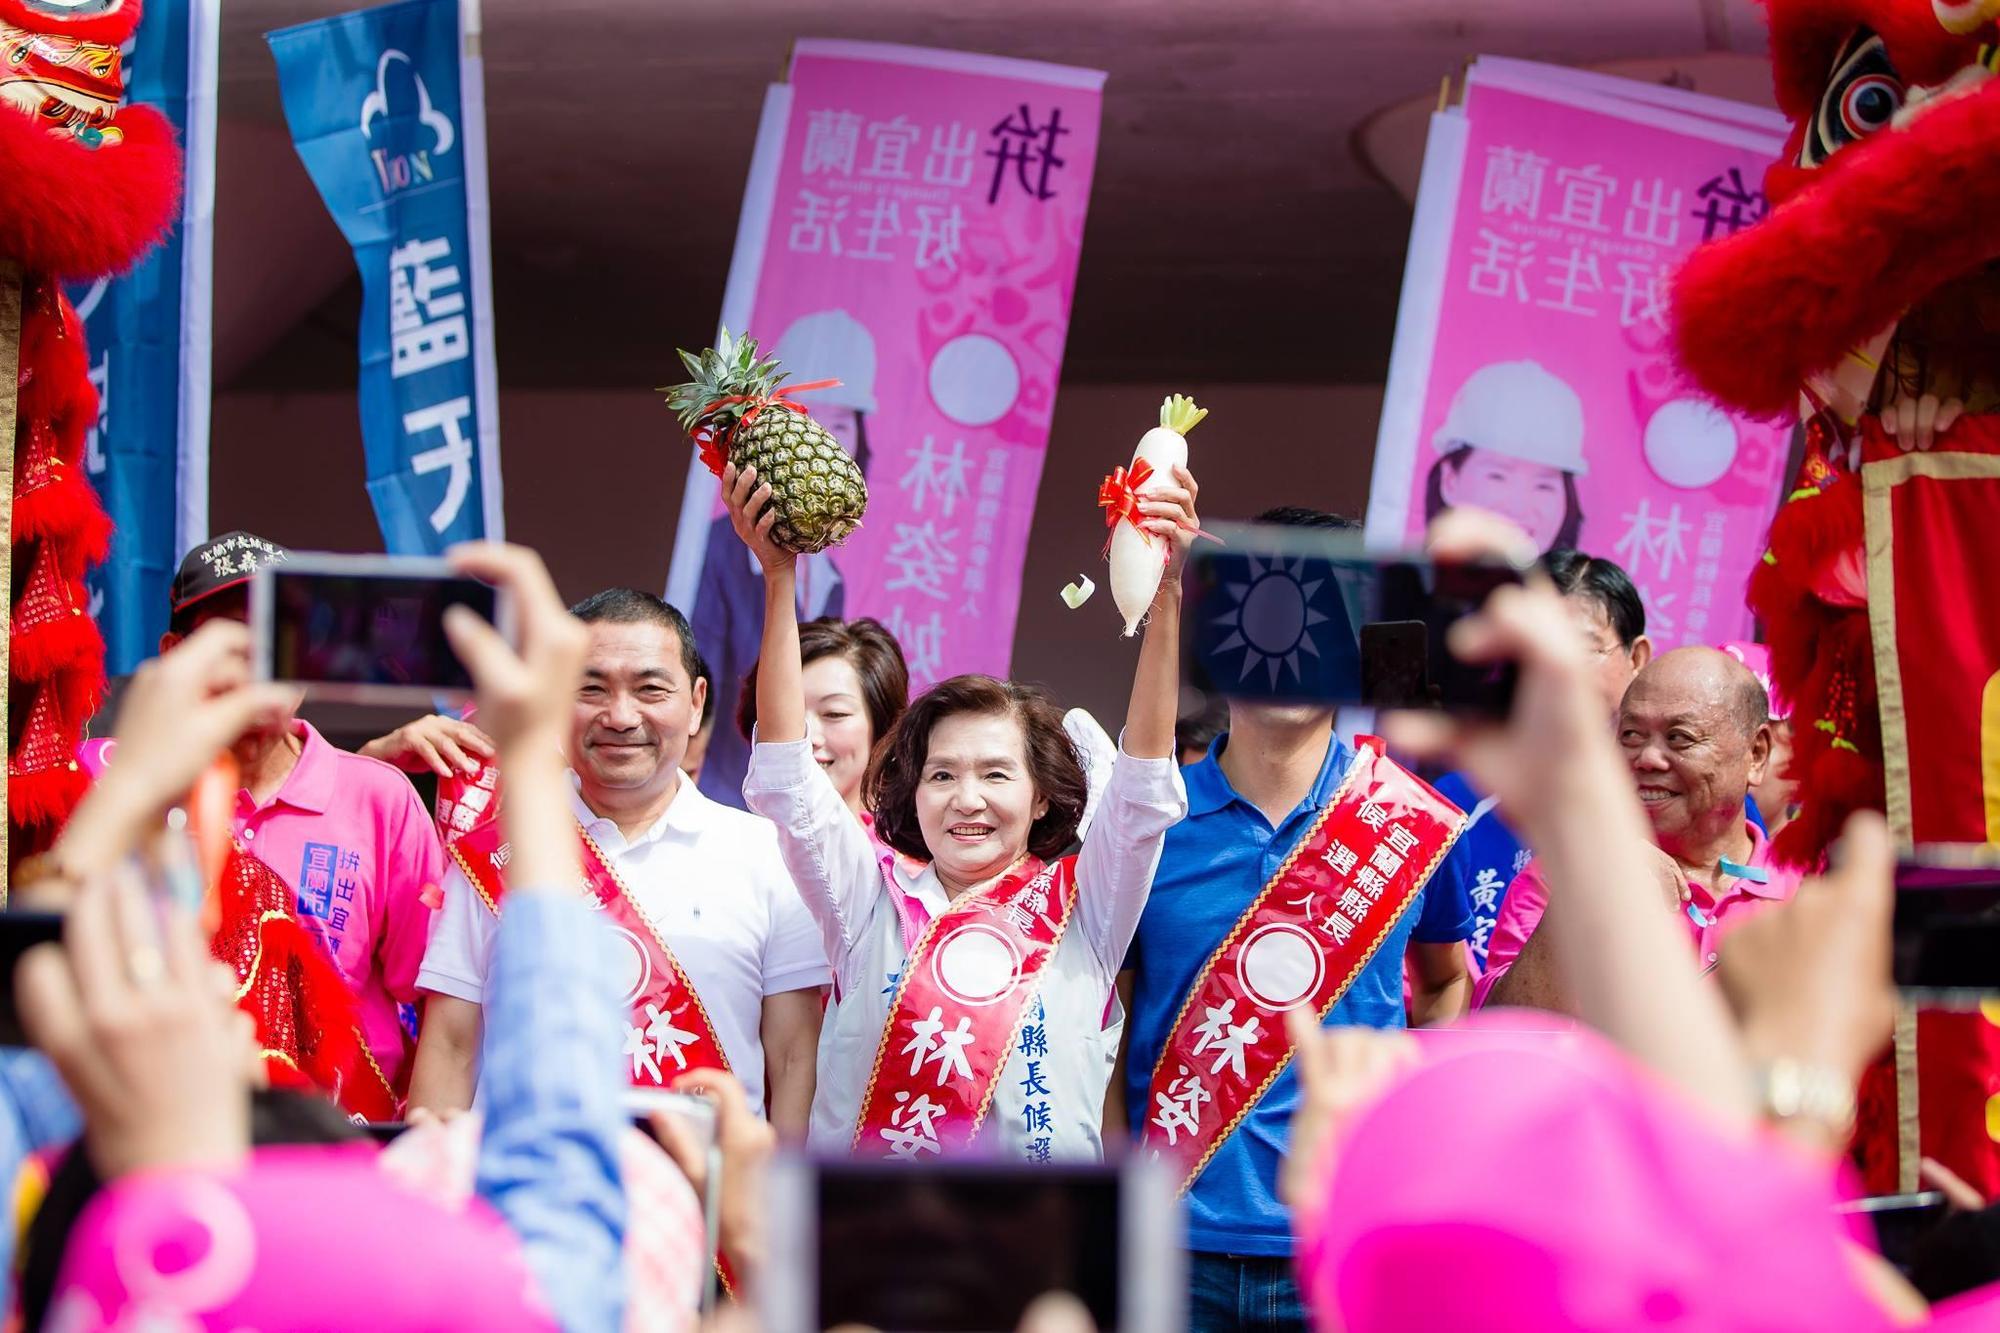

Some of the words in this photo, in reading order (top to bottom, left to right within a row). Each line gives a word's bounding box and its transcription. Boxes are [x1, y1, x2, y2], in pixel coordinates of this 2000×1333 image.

[1318, 822, 1420, 946] 宜蘭縣縣長
